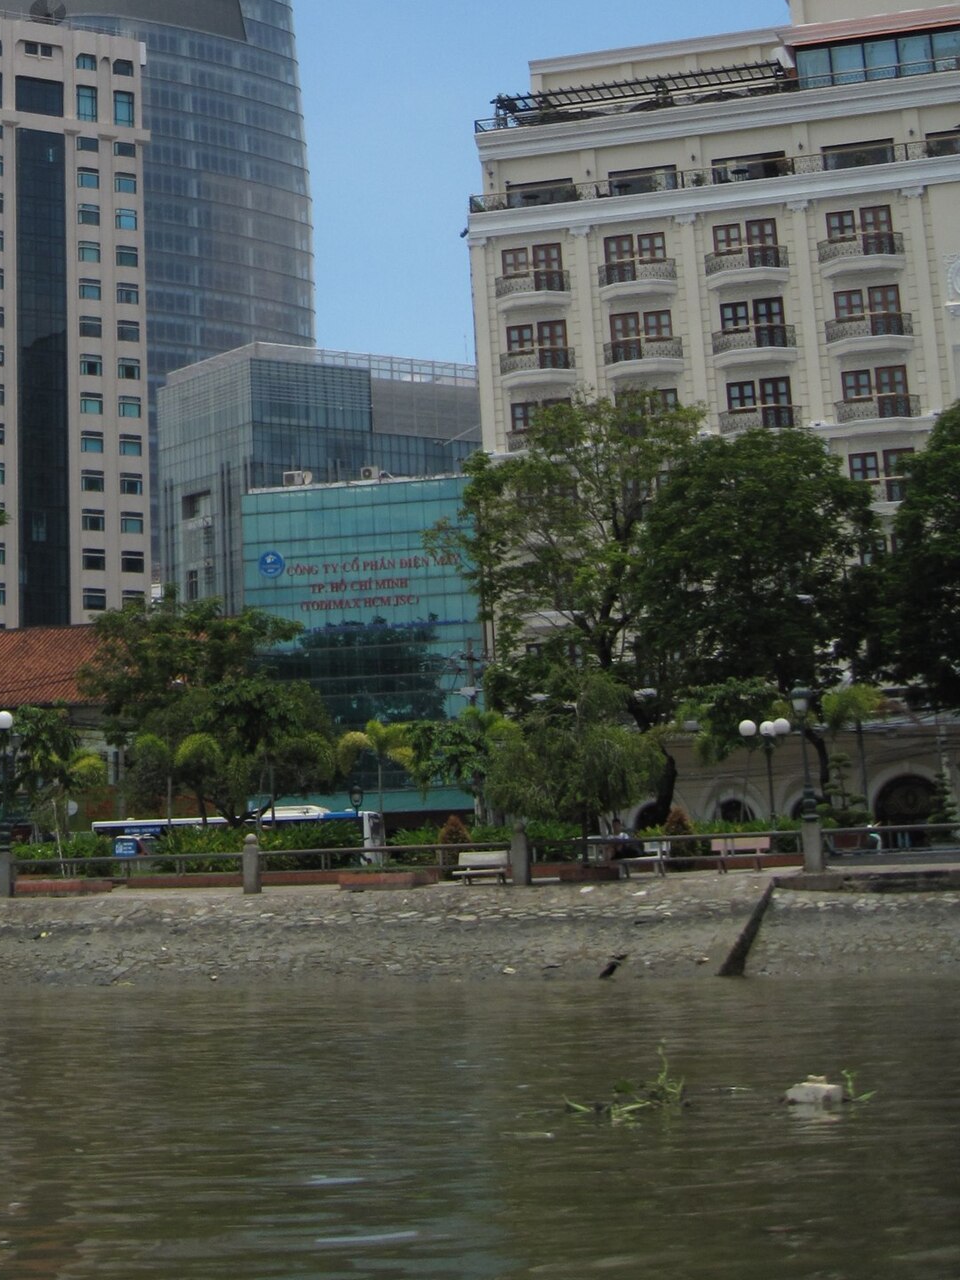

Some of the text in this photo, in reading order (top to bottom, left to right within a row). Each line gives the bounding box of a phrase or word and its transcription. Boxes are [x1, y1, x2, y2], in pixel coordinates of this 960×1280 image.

[323, 563, 338, 574] TY
[375, 578, 408, 590] MINH
[364, 596, 391, 608] HCM
